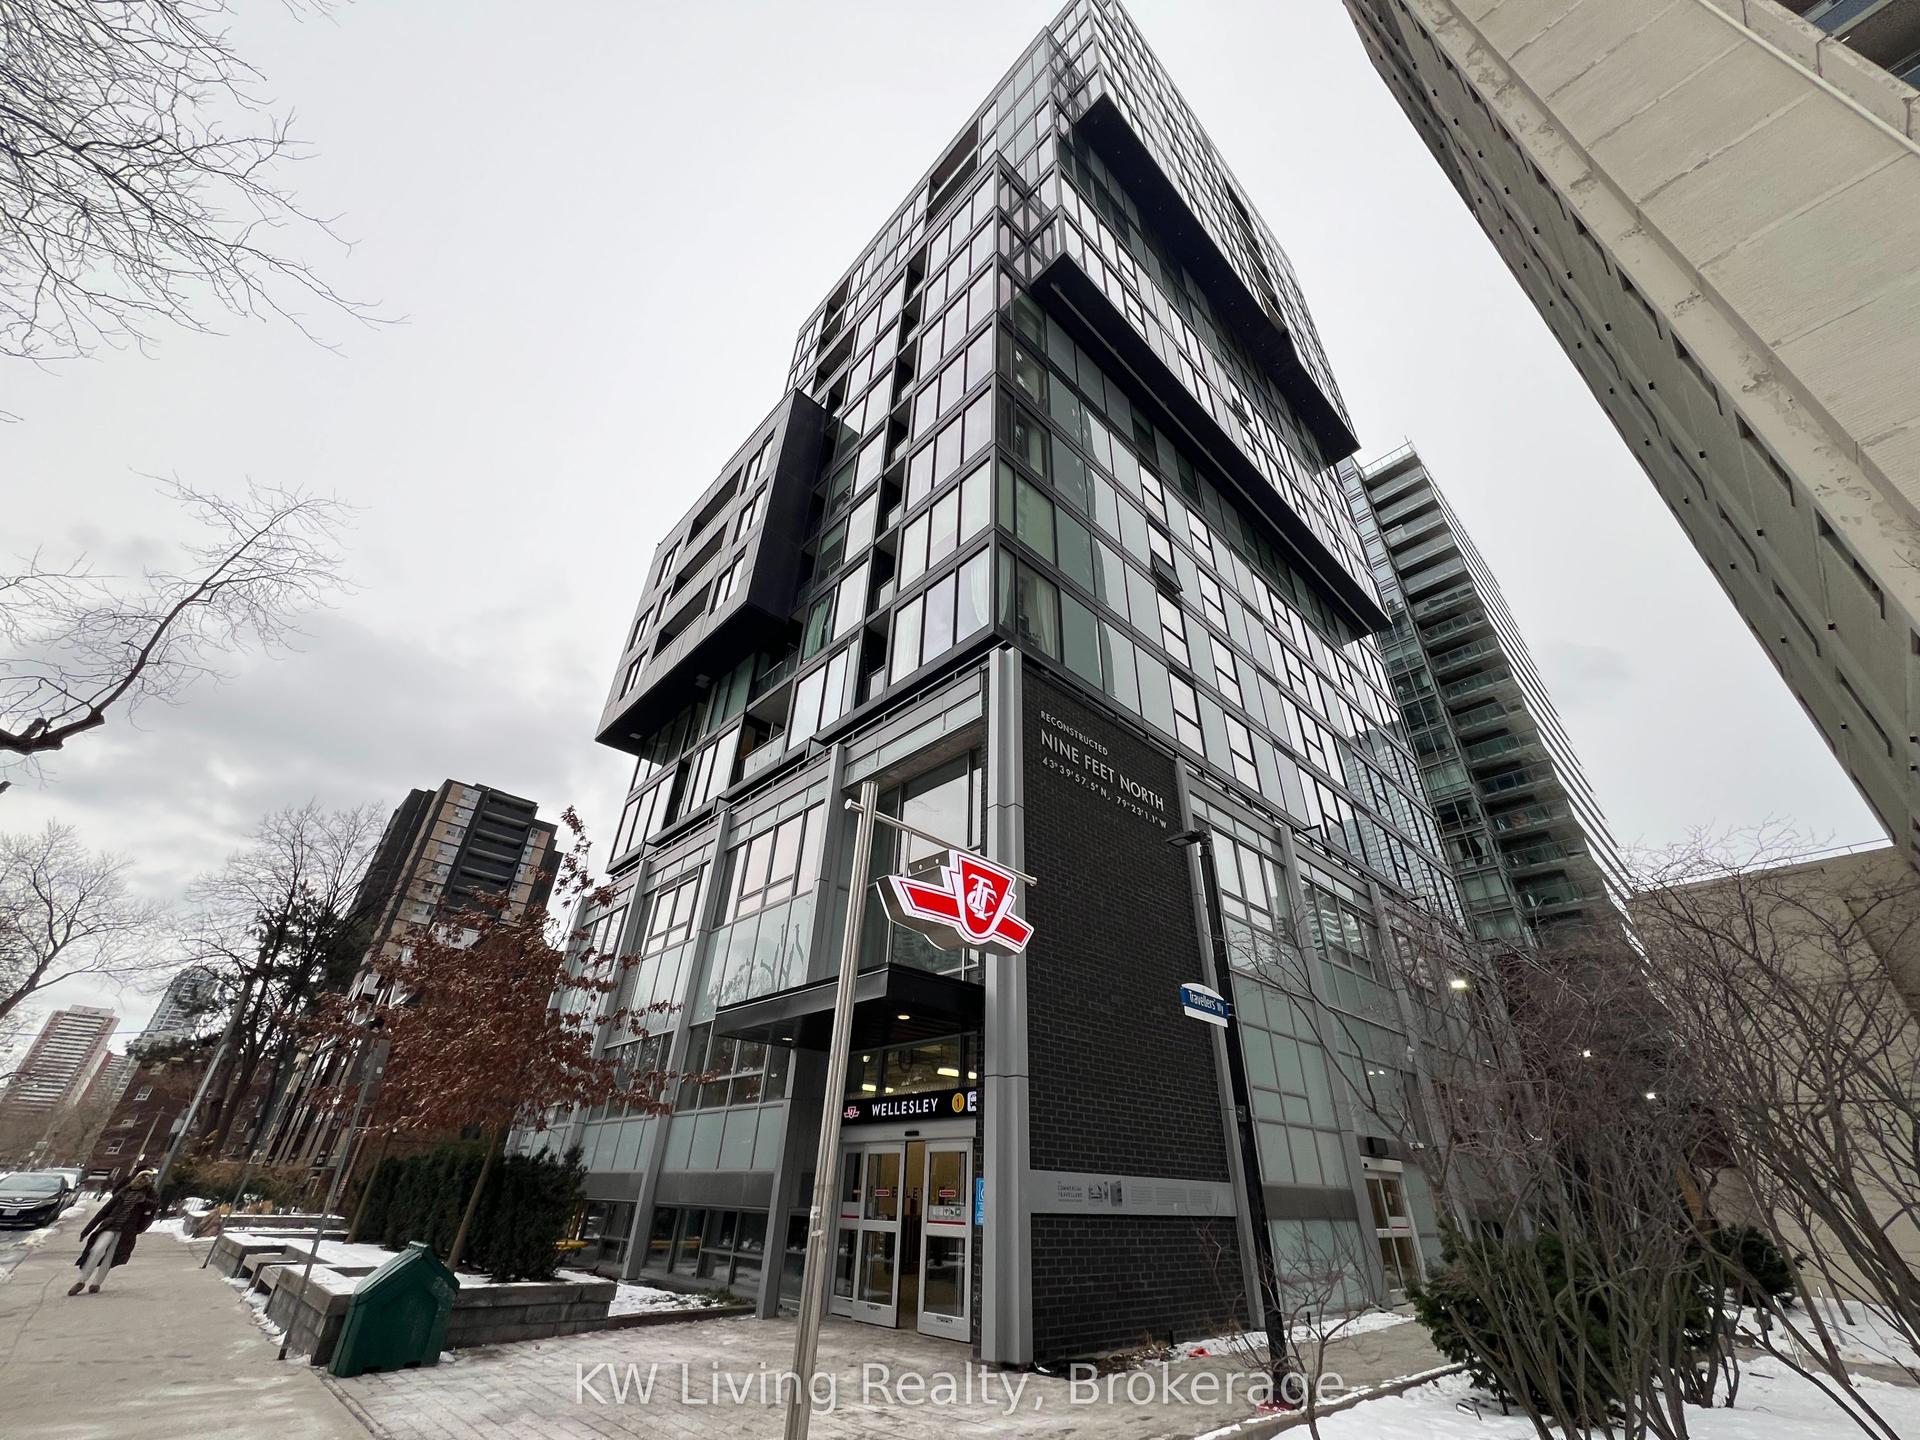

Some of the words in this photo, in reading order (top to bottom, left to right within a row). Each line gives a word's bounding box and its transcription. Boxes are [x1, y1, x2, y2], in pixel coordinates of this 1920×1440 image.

[1040, 710, 1108, 756] RECONSTRUCTED
[1041, 729, 1079, 764] NINE
[1084, 754, 1115, 784] FEET
[1119, 774, 1164, 812] NORTH
[871, 1098, 939, 1117] WELLESLEY
